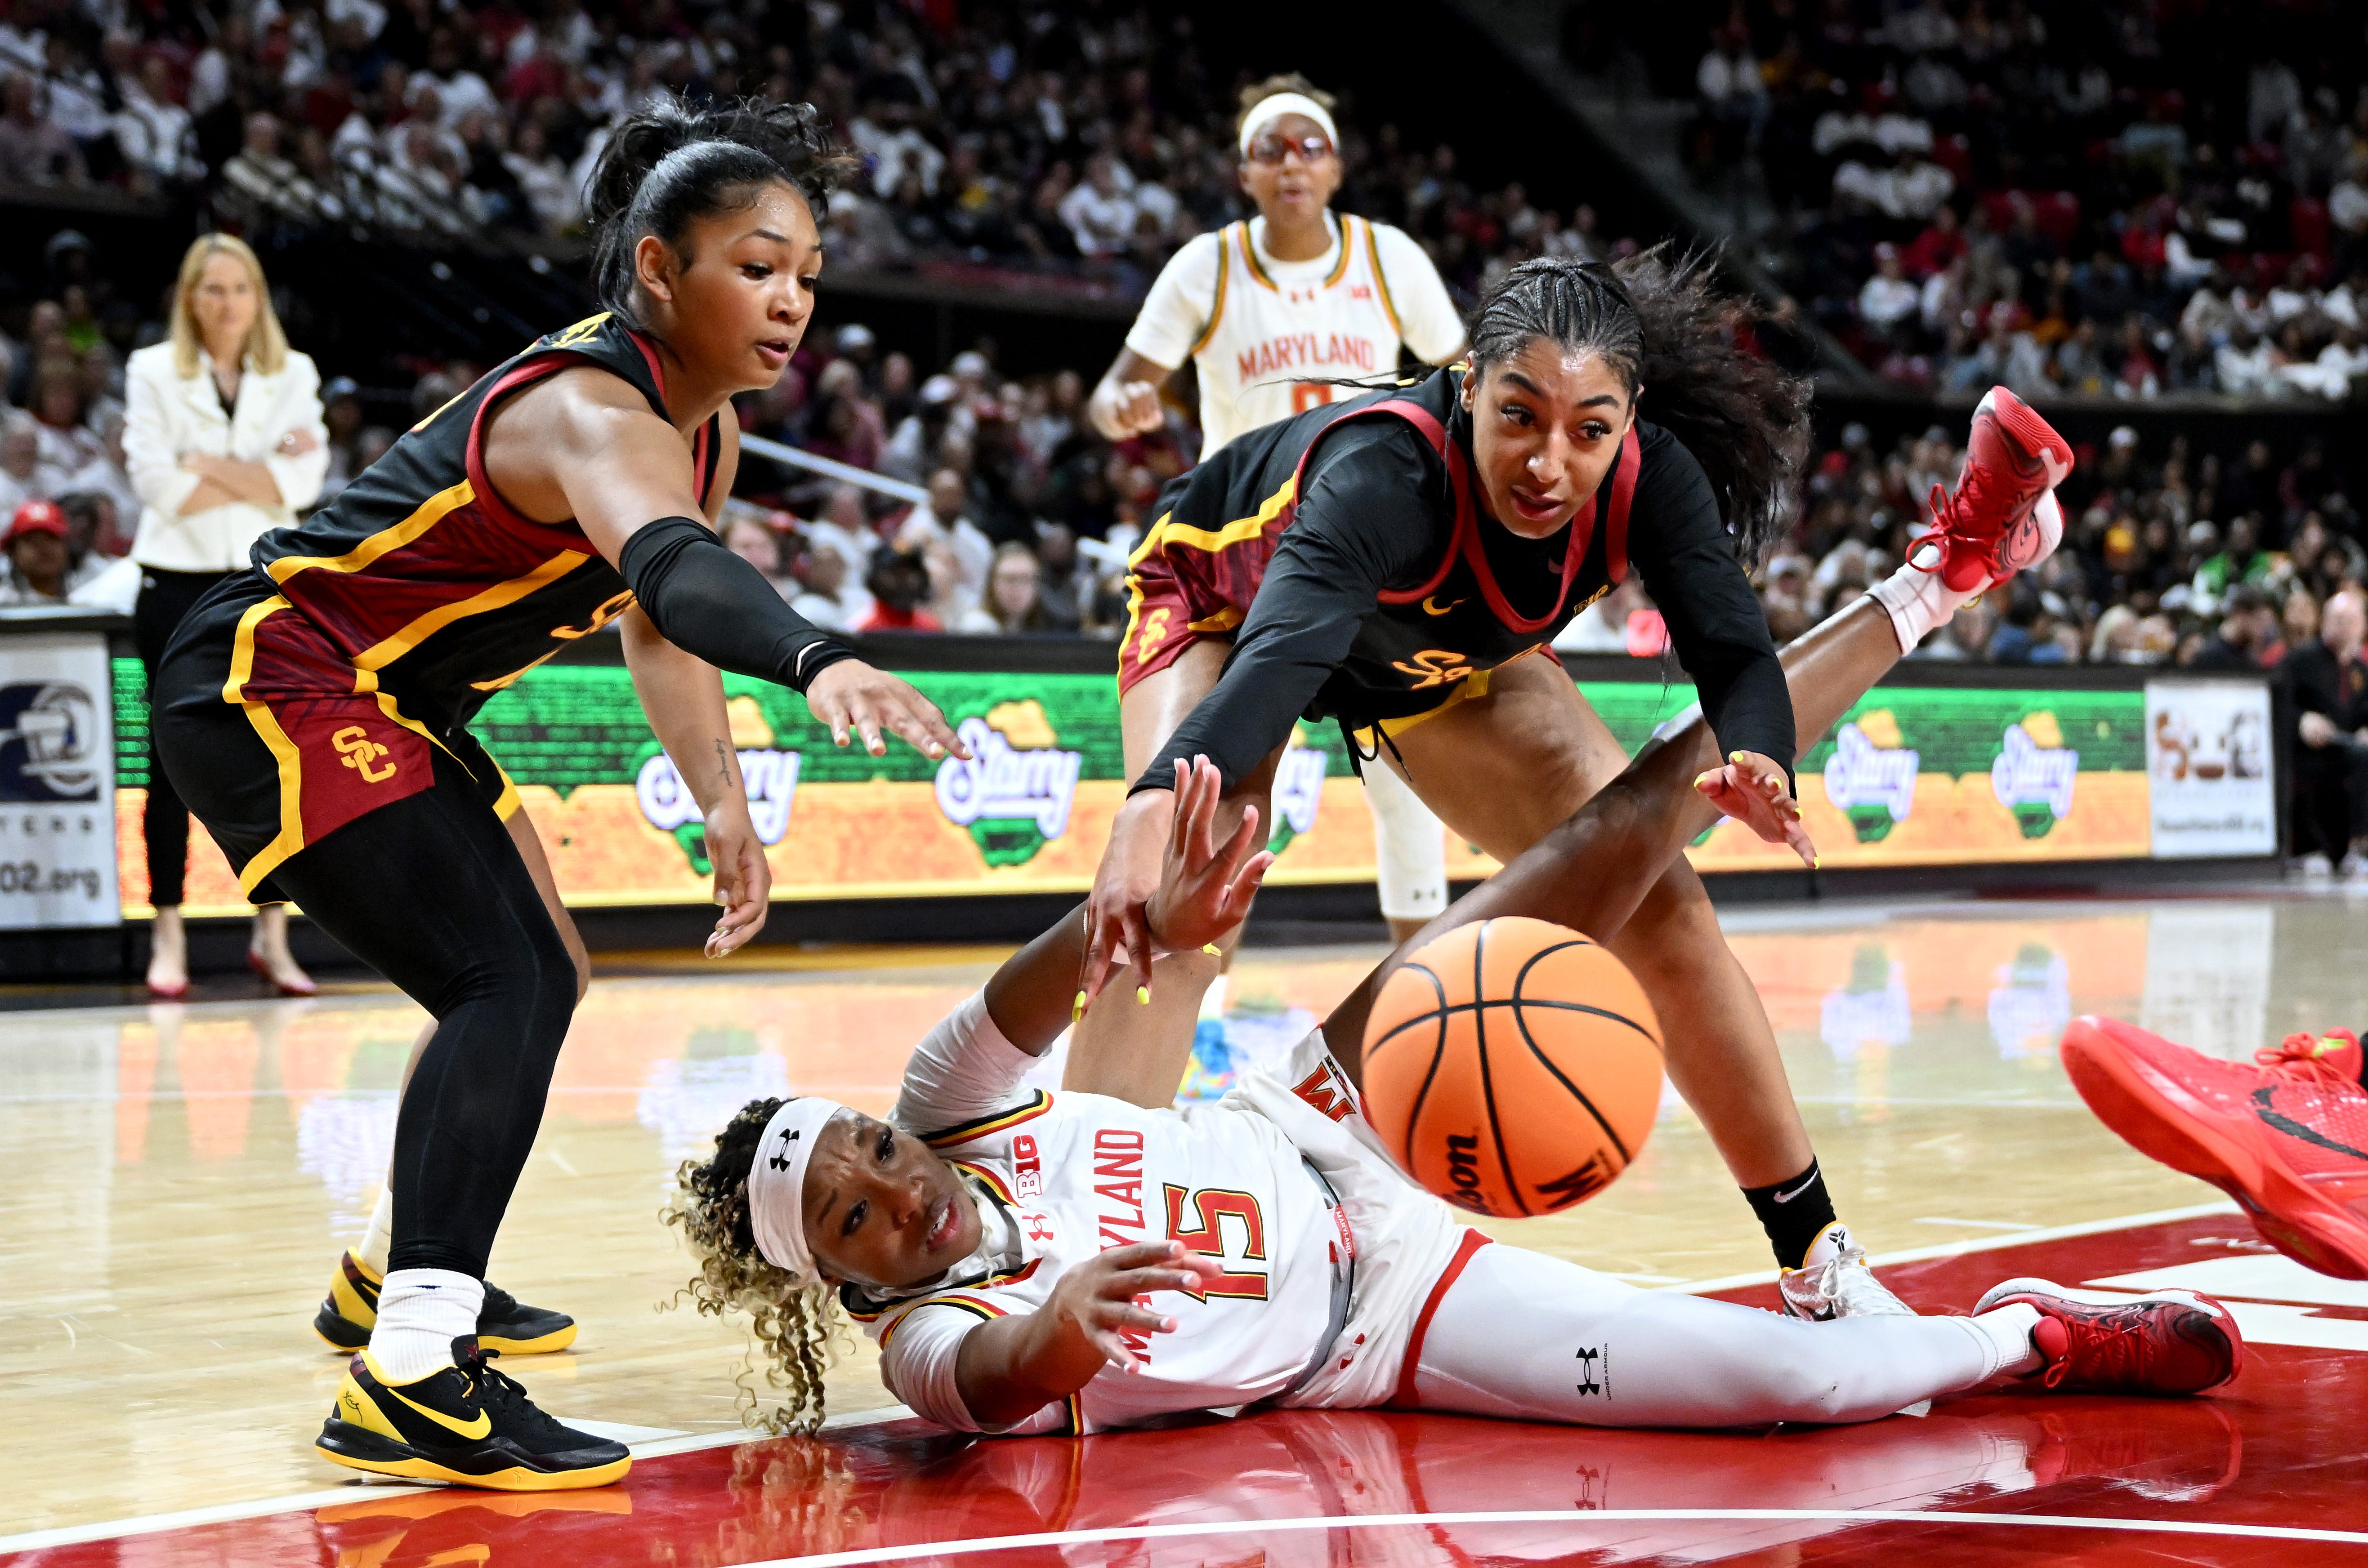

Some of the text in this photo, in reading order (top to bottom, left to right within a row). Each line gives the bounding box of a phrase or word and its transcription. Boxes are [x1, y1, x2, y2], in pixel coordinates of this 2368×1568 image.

[1238, 333, 1375, 385] MARYLAND
[1137, 608, 1171, 664] SC
[331, 726, 397, 784] SC
[1012, 1134, 1042, 1199] B1G
[1162, 1181, 1269, 1305] 15
[1335, 1210, 1352, 1254] MARYLAND
